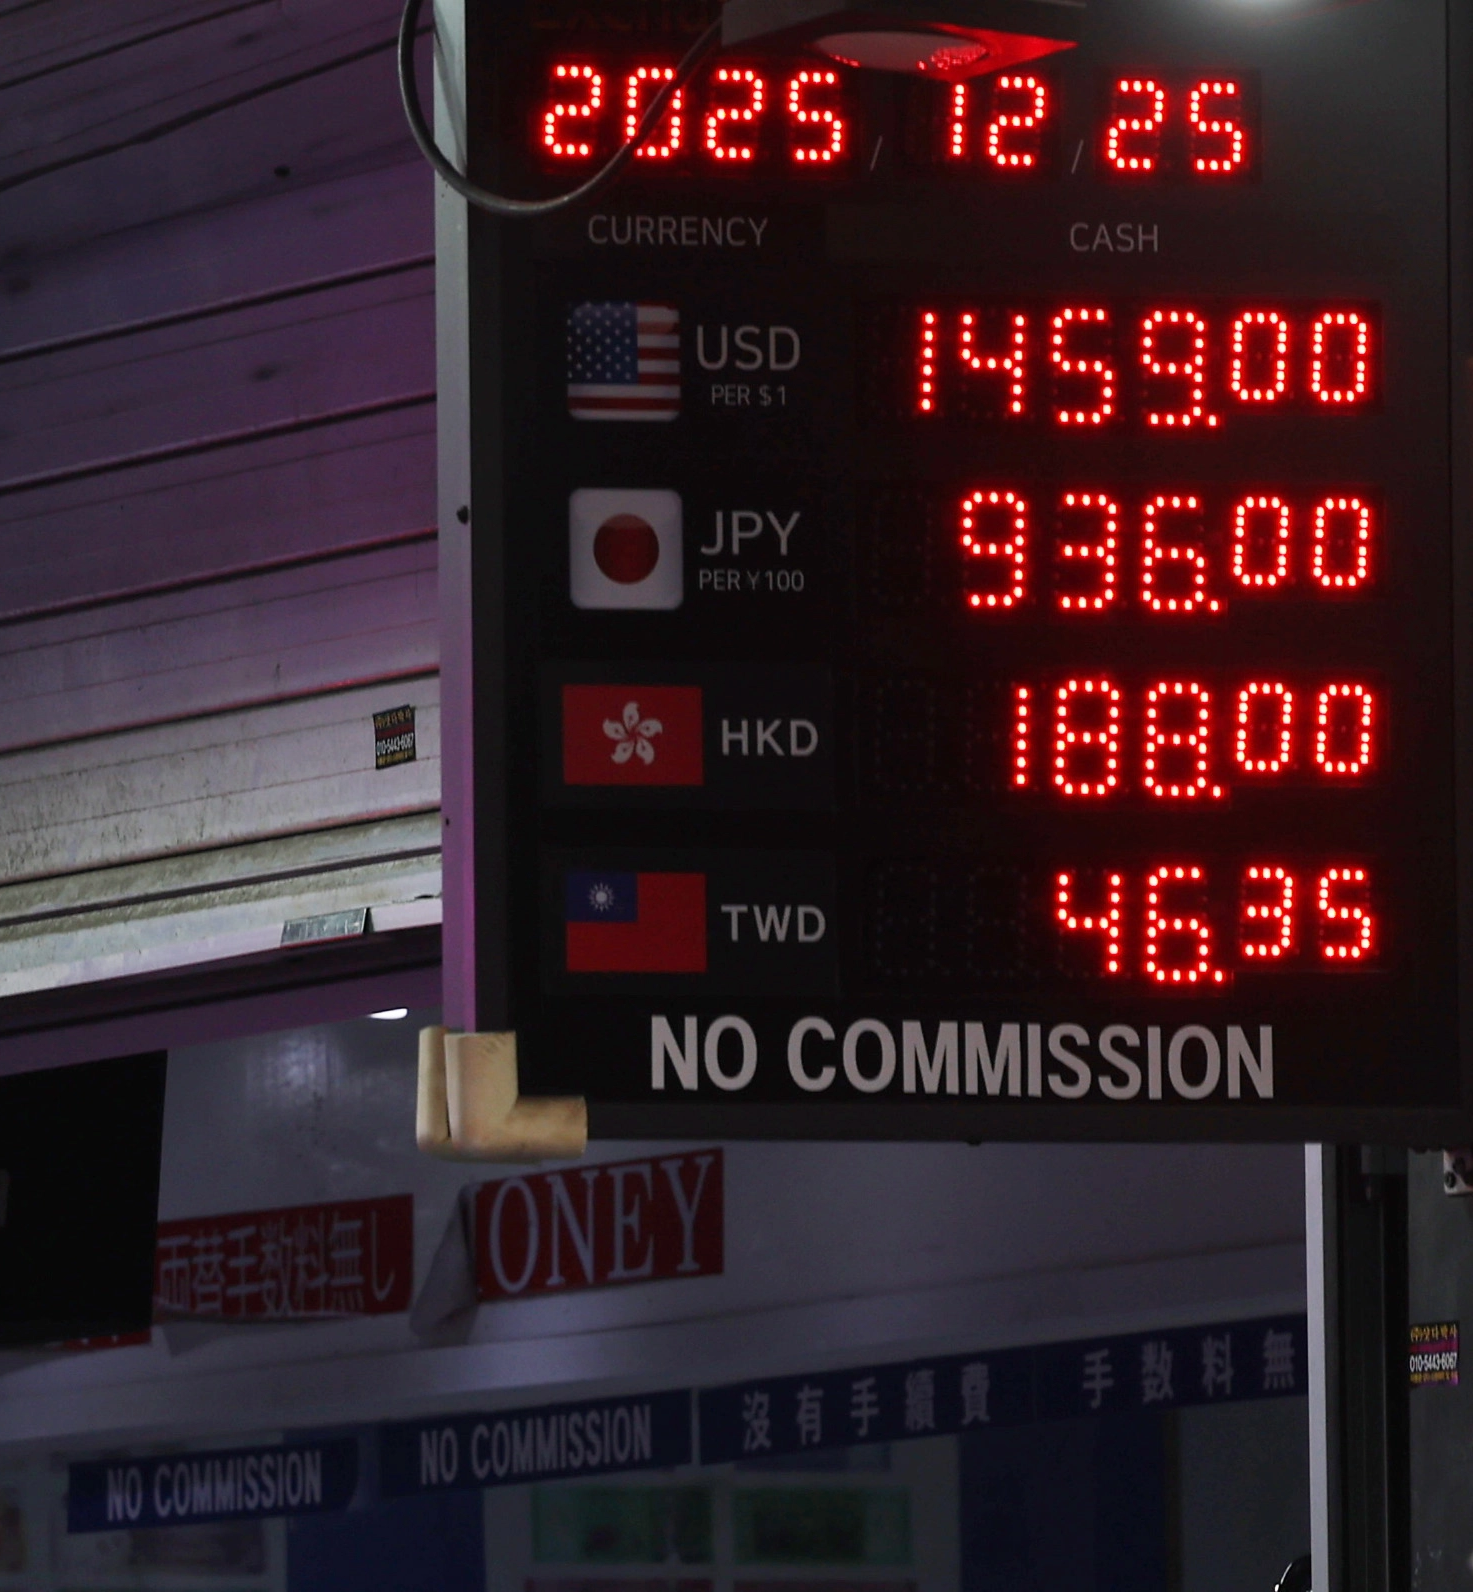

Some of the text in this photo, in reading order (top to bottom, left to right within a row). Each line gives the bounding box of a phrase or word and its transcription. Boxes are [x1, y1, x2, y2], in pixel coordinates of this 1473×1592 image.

[539, 62, 847, 165] 2025
[947, 74, 1050, 169] 12
[1103, 78, 1247, 175] 25
[588, 214, 768, 246] CURRENCY
[1070, 223, 1158, 252] CASH
[696, 306, 1373, 429] USD 1459.00
[711, 384, 750, 406] PER
[699, 569, 741, 591] PER
[700, 490, 1378, 609] JPY 936.00
[722, 677, 1377, 801] HKD 188.00
[720, 864, 1376, 986] TWD 46.35
[651, 1015, 1274, 1100] NO COMMISSION
[489, 1156, 713, 1295] ONEY
[1410, 1352, 1457, 1373] 010-5443-6067
[421, 1404, 653, 1485] NO COMMISSION
[107, 1452, 321, 1521] NO COMMISSION
